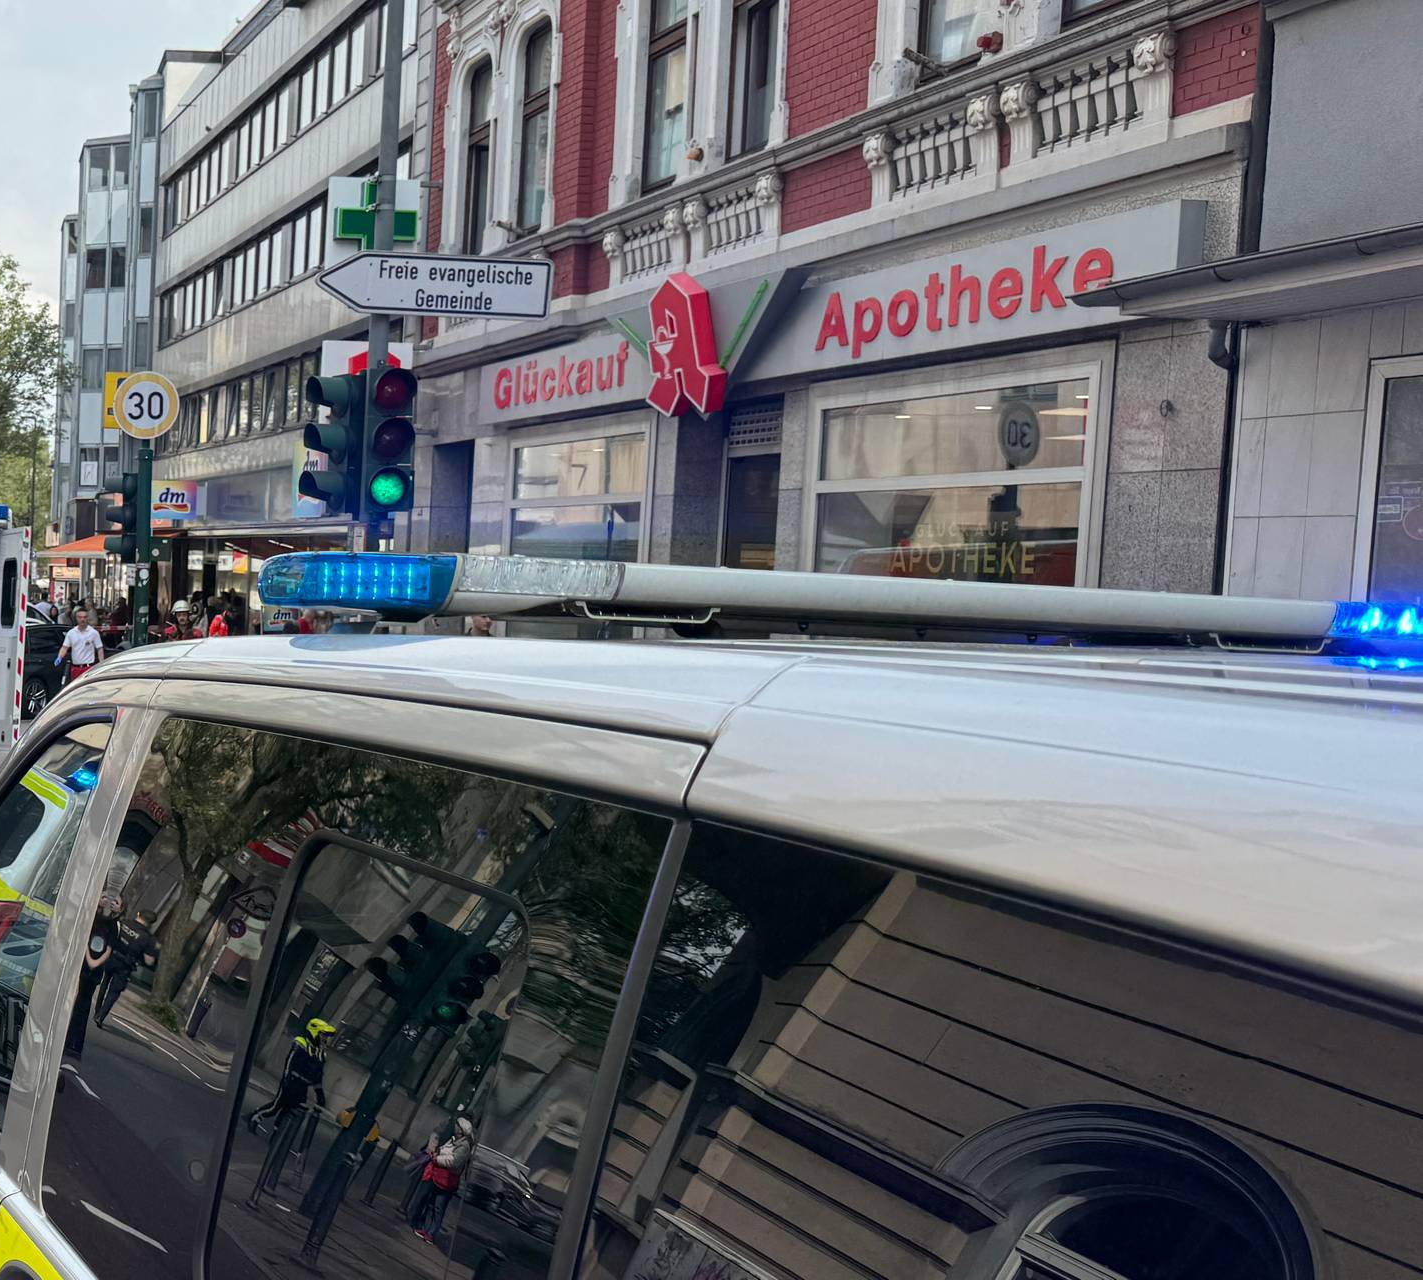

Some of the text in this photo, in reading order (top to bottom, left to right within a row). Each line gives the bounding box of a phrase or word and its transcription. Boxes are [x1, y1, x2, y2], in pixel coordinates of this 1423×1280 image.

[378, 259, 533, 288] Freie evangelische
[415, 288, 493, 311] Gemeinde
[815, 245, 1114, 359] Apotheke
[493, 340, 630, 410] Glückauf
[128, 391, 164, 420] 30
[159, 487, 186, 504] dm
[890, 541, 1036, 576] APOTHEKE
[273, 609, 291, 621] dm
